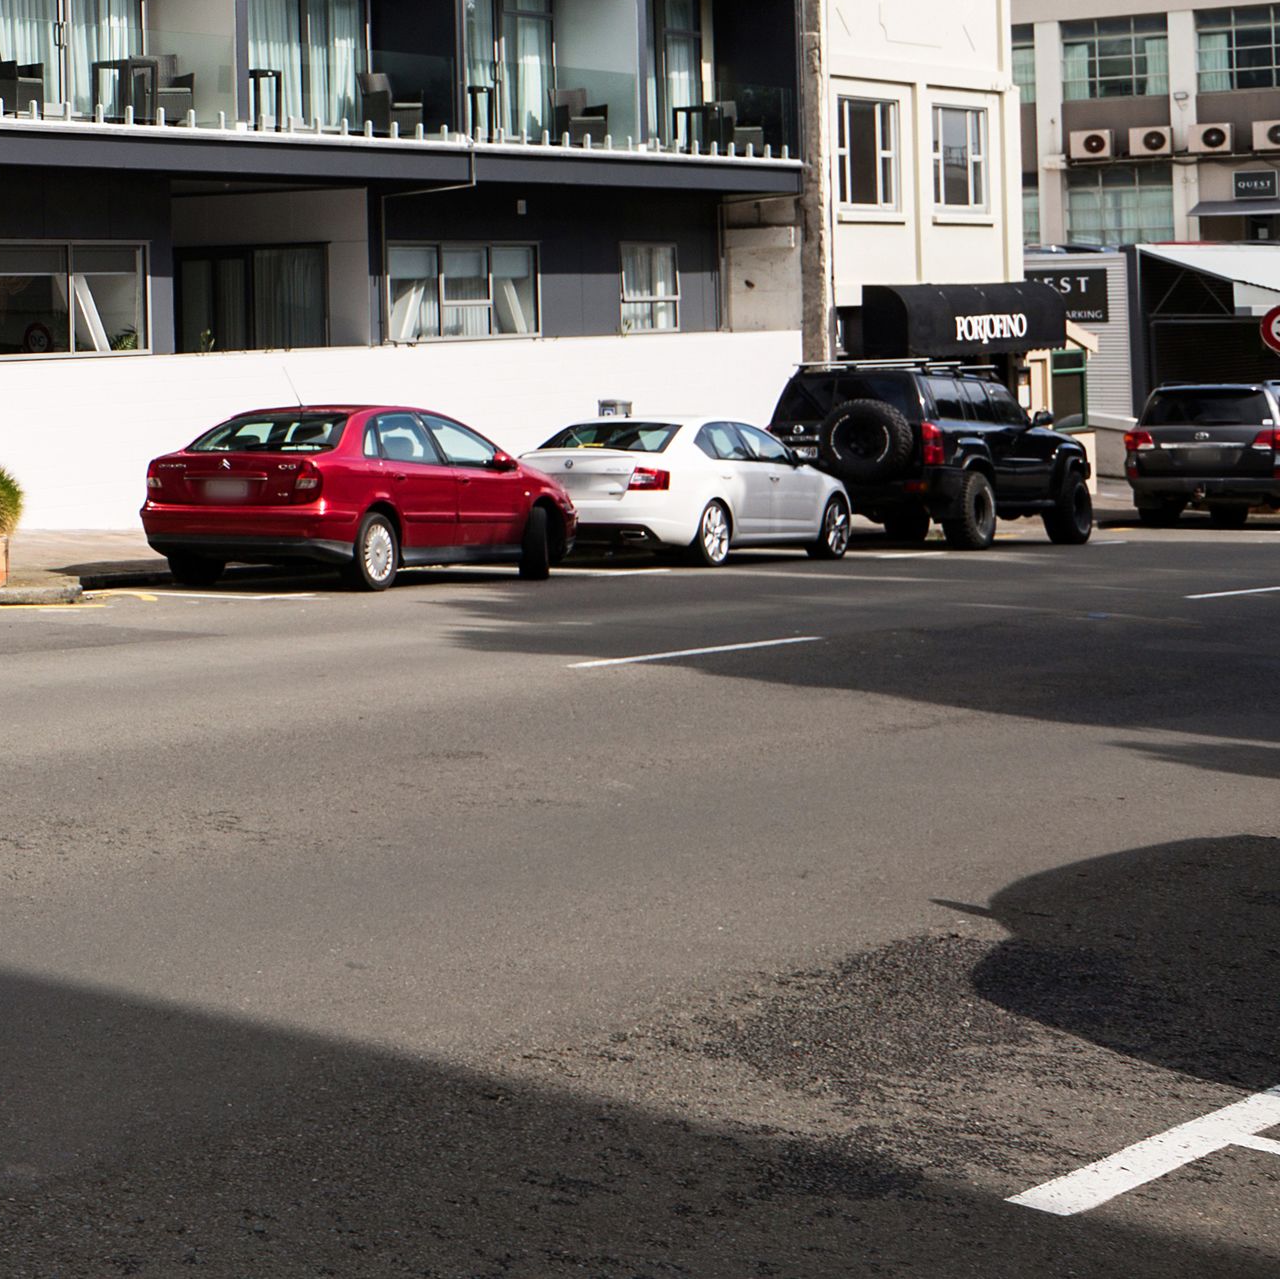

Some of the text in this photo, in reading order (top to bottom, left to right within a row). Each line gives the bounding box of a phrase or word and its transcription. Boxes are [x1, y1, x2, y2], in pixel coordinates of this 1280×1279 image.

[1238, 180, 1270, 189] QUEST
[1032, 276, 1089, 294] EST
[1066, 309, 1103, 319] ARKING
[955, 312, 1028, 345] PORTOFINO
